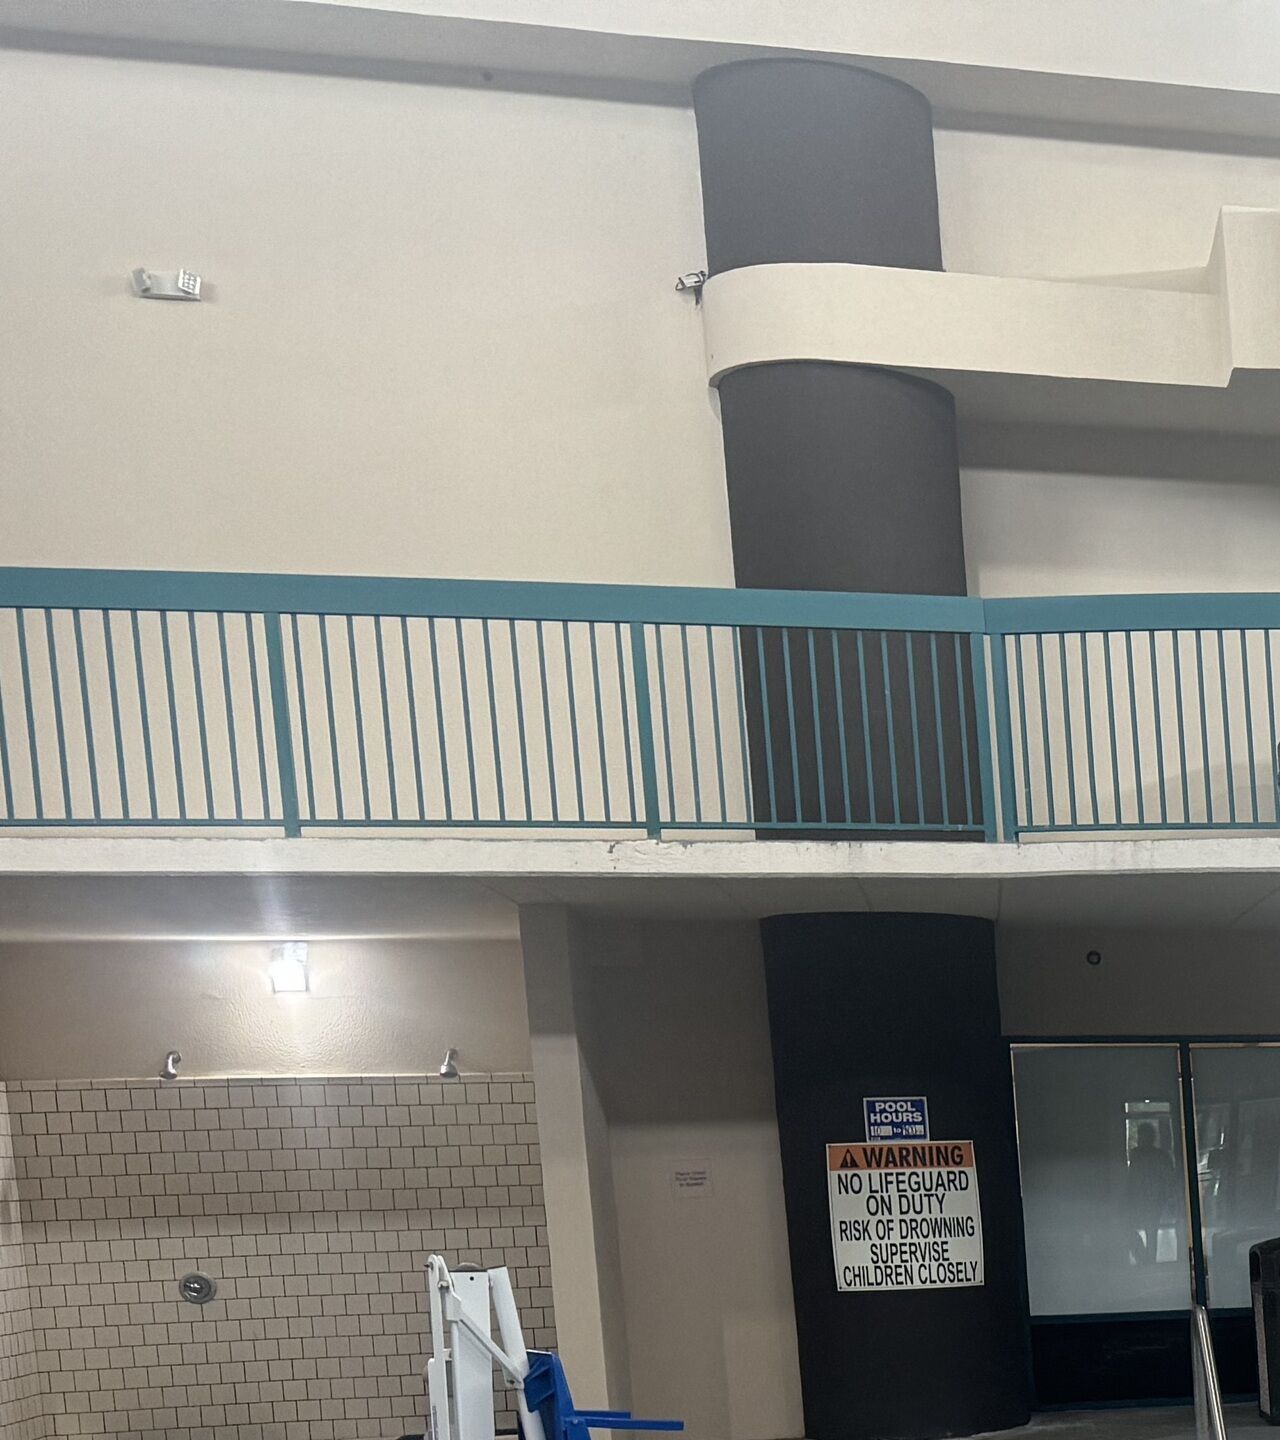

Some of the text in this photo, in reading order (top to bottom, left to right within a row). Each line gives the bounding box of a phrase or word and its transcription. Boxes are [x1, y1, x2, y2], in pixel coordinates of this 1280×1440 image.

[870, 1112, 923, 1123] HOURS
[875, 1101, 916, 1112] POOL
[862, 1145, 964, 1167] WARNING
[838, 1170, 969, 1195] NO LIFEGUARD
[866, 1193, 946, 1216] ON DUTY
[839, 1216, 975, 1242] RISK OF DROWNING
[870, 1241, 950, 1264] SUPERVISE
[843, 1261, 978, 1287] CHILDREN CLOSELY
